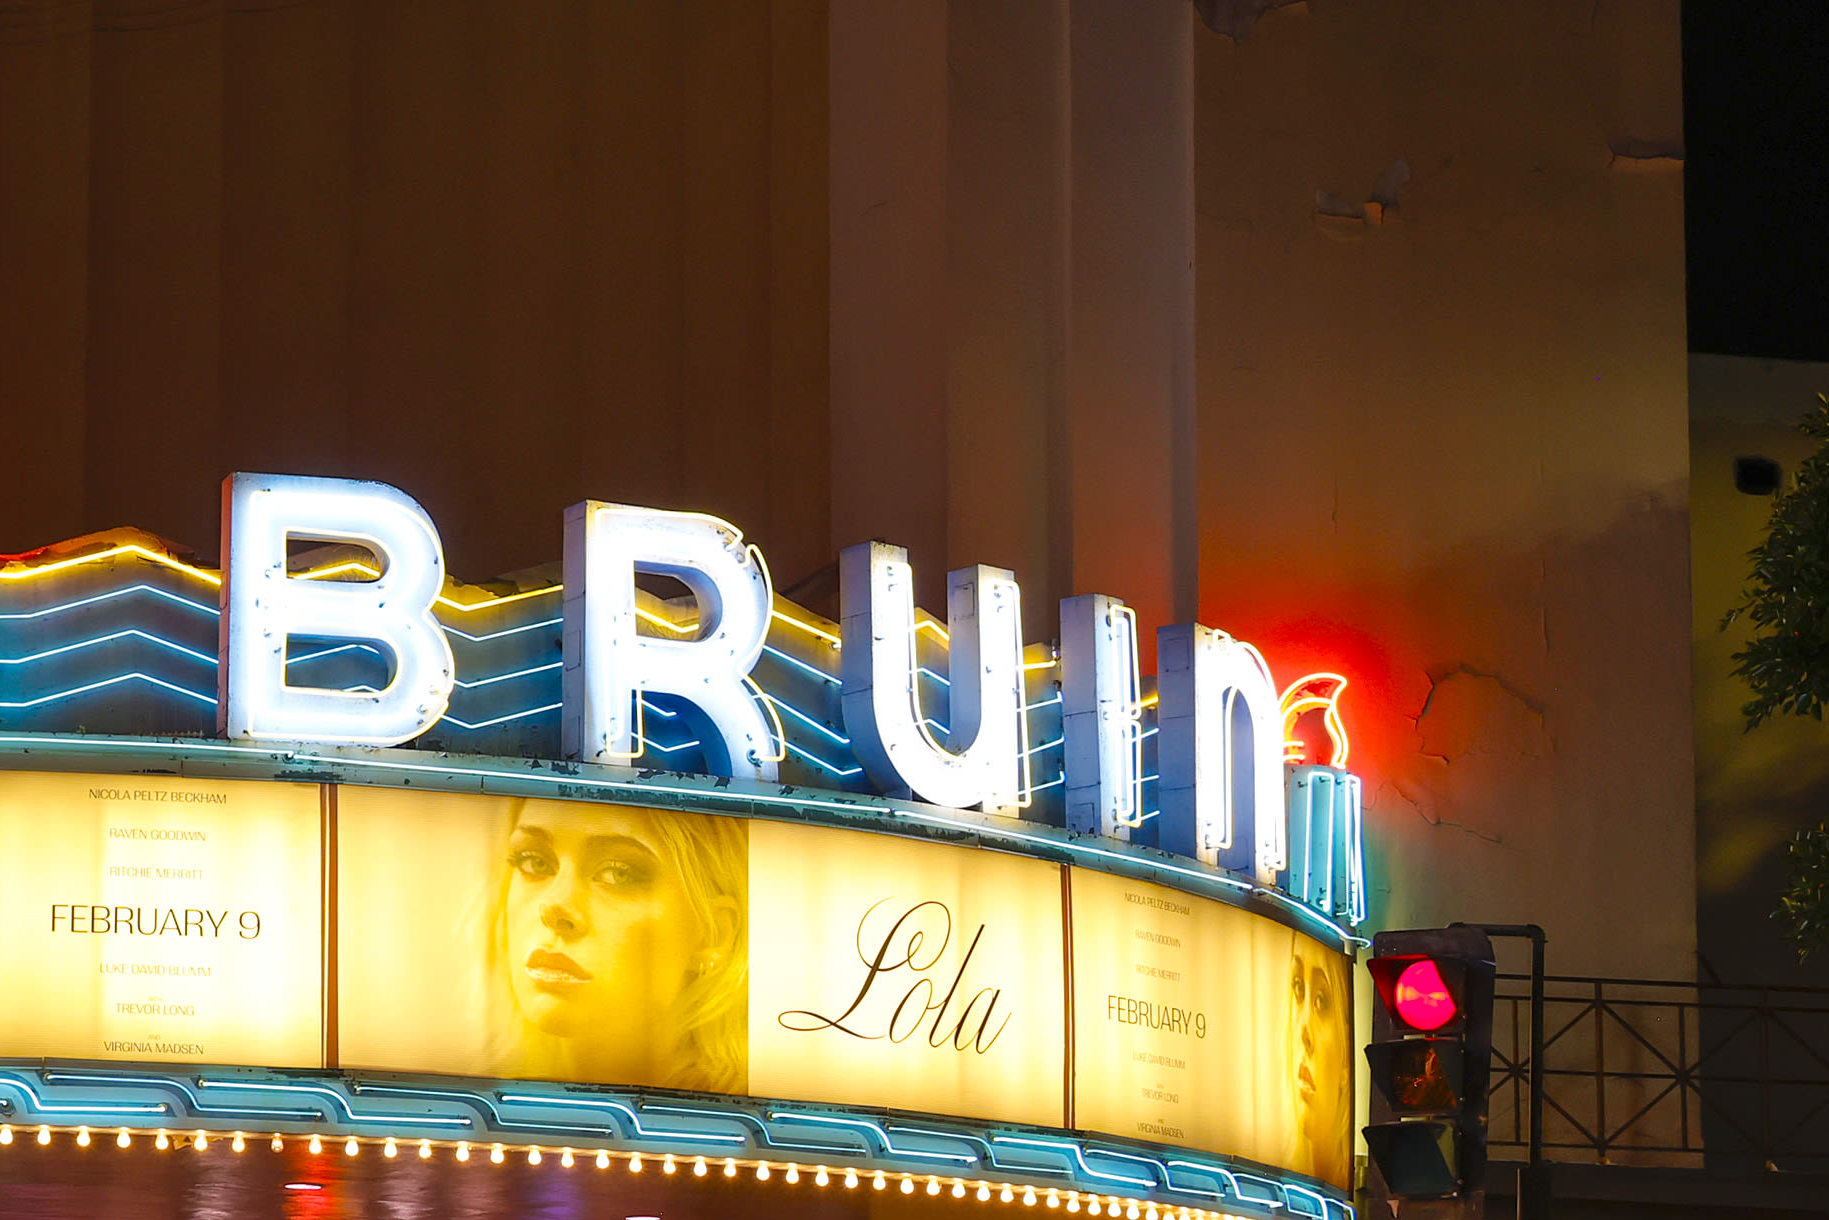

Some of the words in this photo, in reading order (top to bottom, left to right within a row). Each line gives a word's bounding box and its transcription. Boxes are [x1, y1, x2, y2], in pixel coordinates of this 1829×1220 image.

[222, 473, 1288, 887] BRUIN
[89, 788, 131, 801] NICOLA
[133, 790, 168, 802] PELTZ
[171, 792, 227, 804] BECKHAM
[109, 828, 148, 840] RAVEN
[150, 829, 206, 842] GOODWIN
[109, 866, 154, 878] RITCHIE
[156, 867, 204, 880] MERRITT
[51, 904, 228, 938] FEBRUARY
[238, 911, 261, 940] 9
[99, 962, 130, 974] LUKE
[131, 963, 166, 976] DAVID
[777, 895, 1012, 1055] Lola
[116, 1003, 161, 1015] TREVOR
[163, 1004, 195, 1016] LONG
[1108, 995, 1192, 1035] FEBRUARY
[1195, 1013, 1206, 1039] 9
[103, 1040, 152, 1053] VIRGINIA
[154, 1042, 204, 1055] MADSEN
